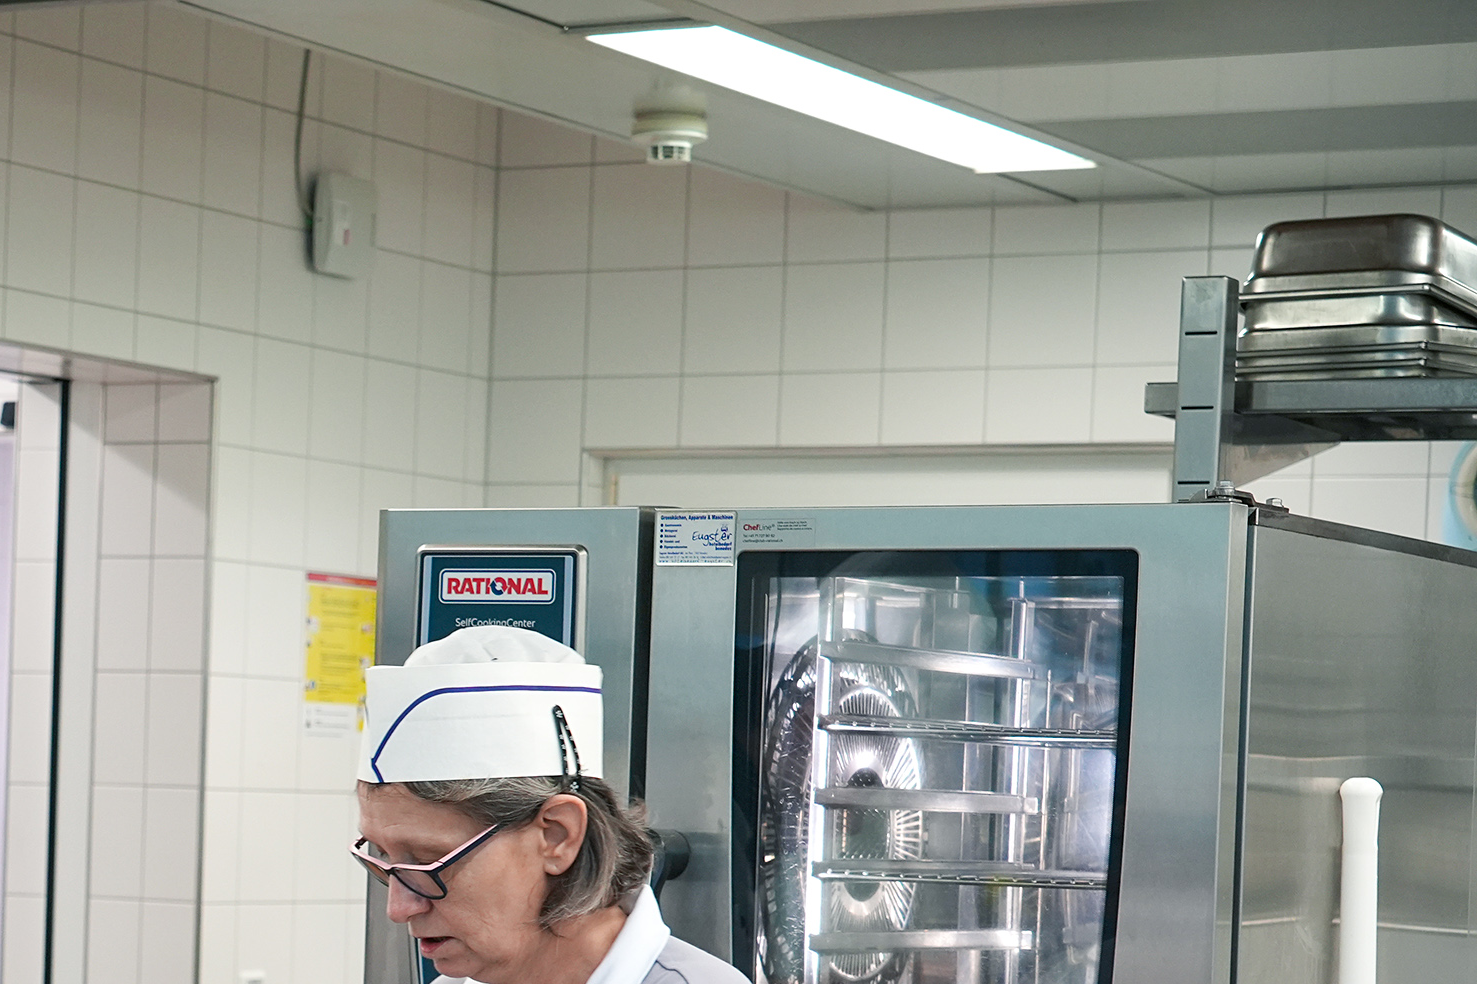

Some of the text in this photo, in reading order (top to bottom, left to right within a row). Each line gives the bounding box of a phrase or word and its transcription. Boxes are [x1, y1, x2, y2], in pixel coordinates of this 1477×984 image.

[692, 529, 732, 546] Eugster
[447, 577, 548, 595] RATIONAL
[456, 618, 536, 628] SelfCookingCenter
